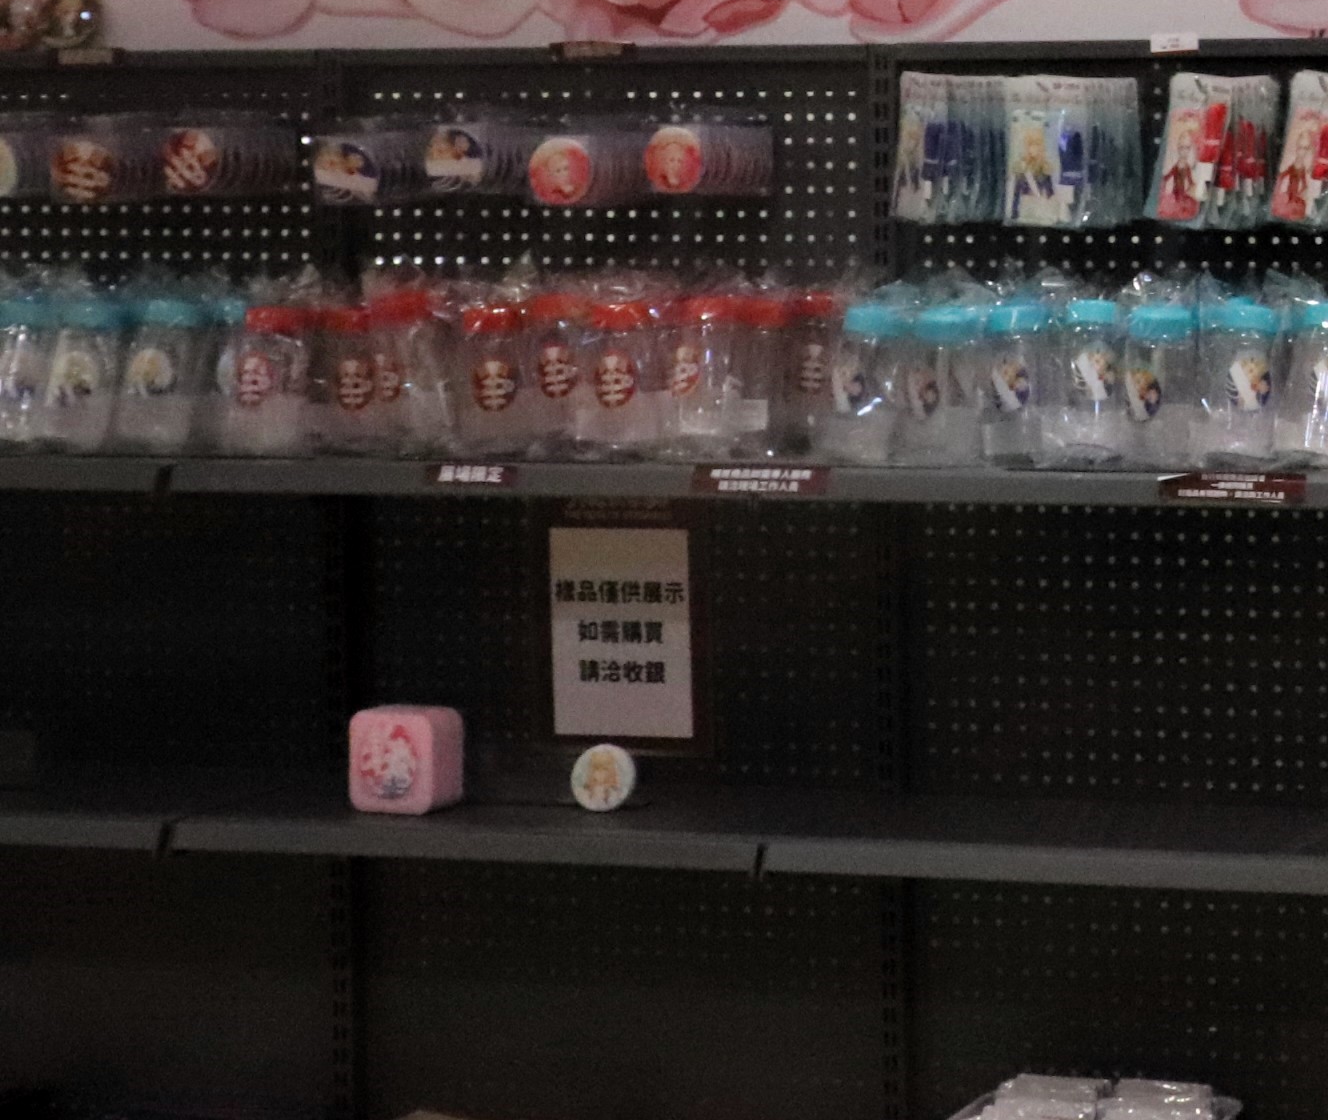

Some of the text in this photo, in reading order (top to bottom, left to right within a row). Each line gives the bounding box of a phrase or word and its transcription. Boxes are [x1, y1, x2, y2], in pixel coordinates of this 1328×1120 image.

[555, 581, 684, 604] 樣品僅供展示
[578, 620, 663, 643] 如需購買
[579, 660, 665, 683] 請洽收銀
